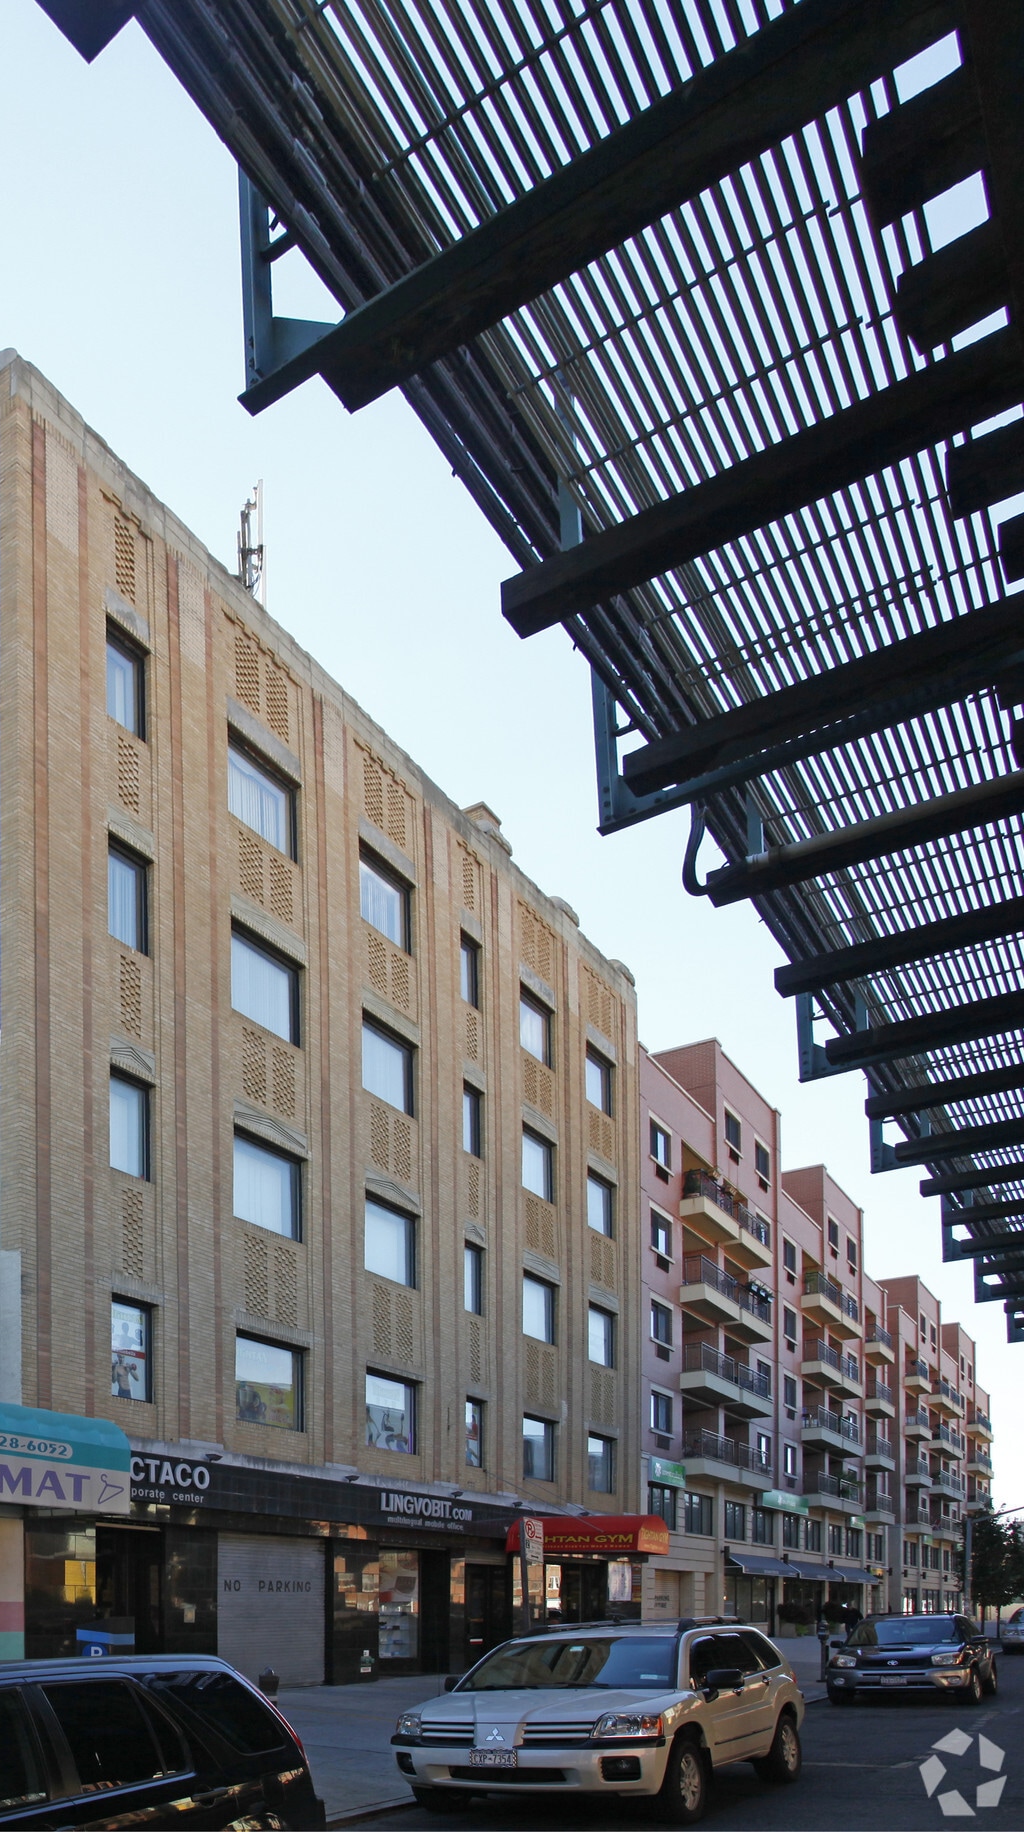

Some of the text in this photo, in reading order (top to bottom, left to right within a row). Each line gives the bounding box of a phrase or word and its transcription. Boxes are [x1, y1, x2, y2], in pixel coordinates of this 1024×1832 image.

[130, 1456, 210, 1490] CTACO
[172, 1492, 204, 1503] center
[544, 1533, 634, 1544] HTAN GYM
[224, 1580, 312, 1593] NO PARKING
